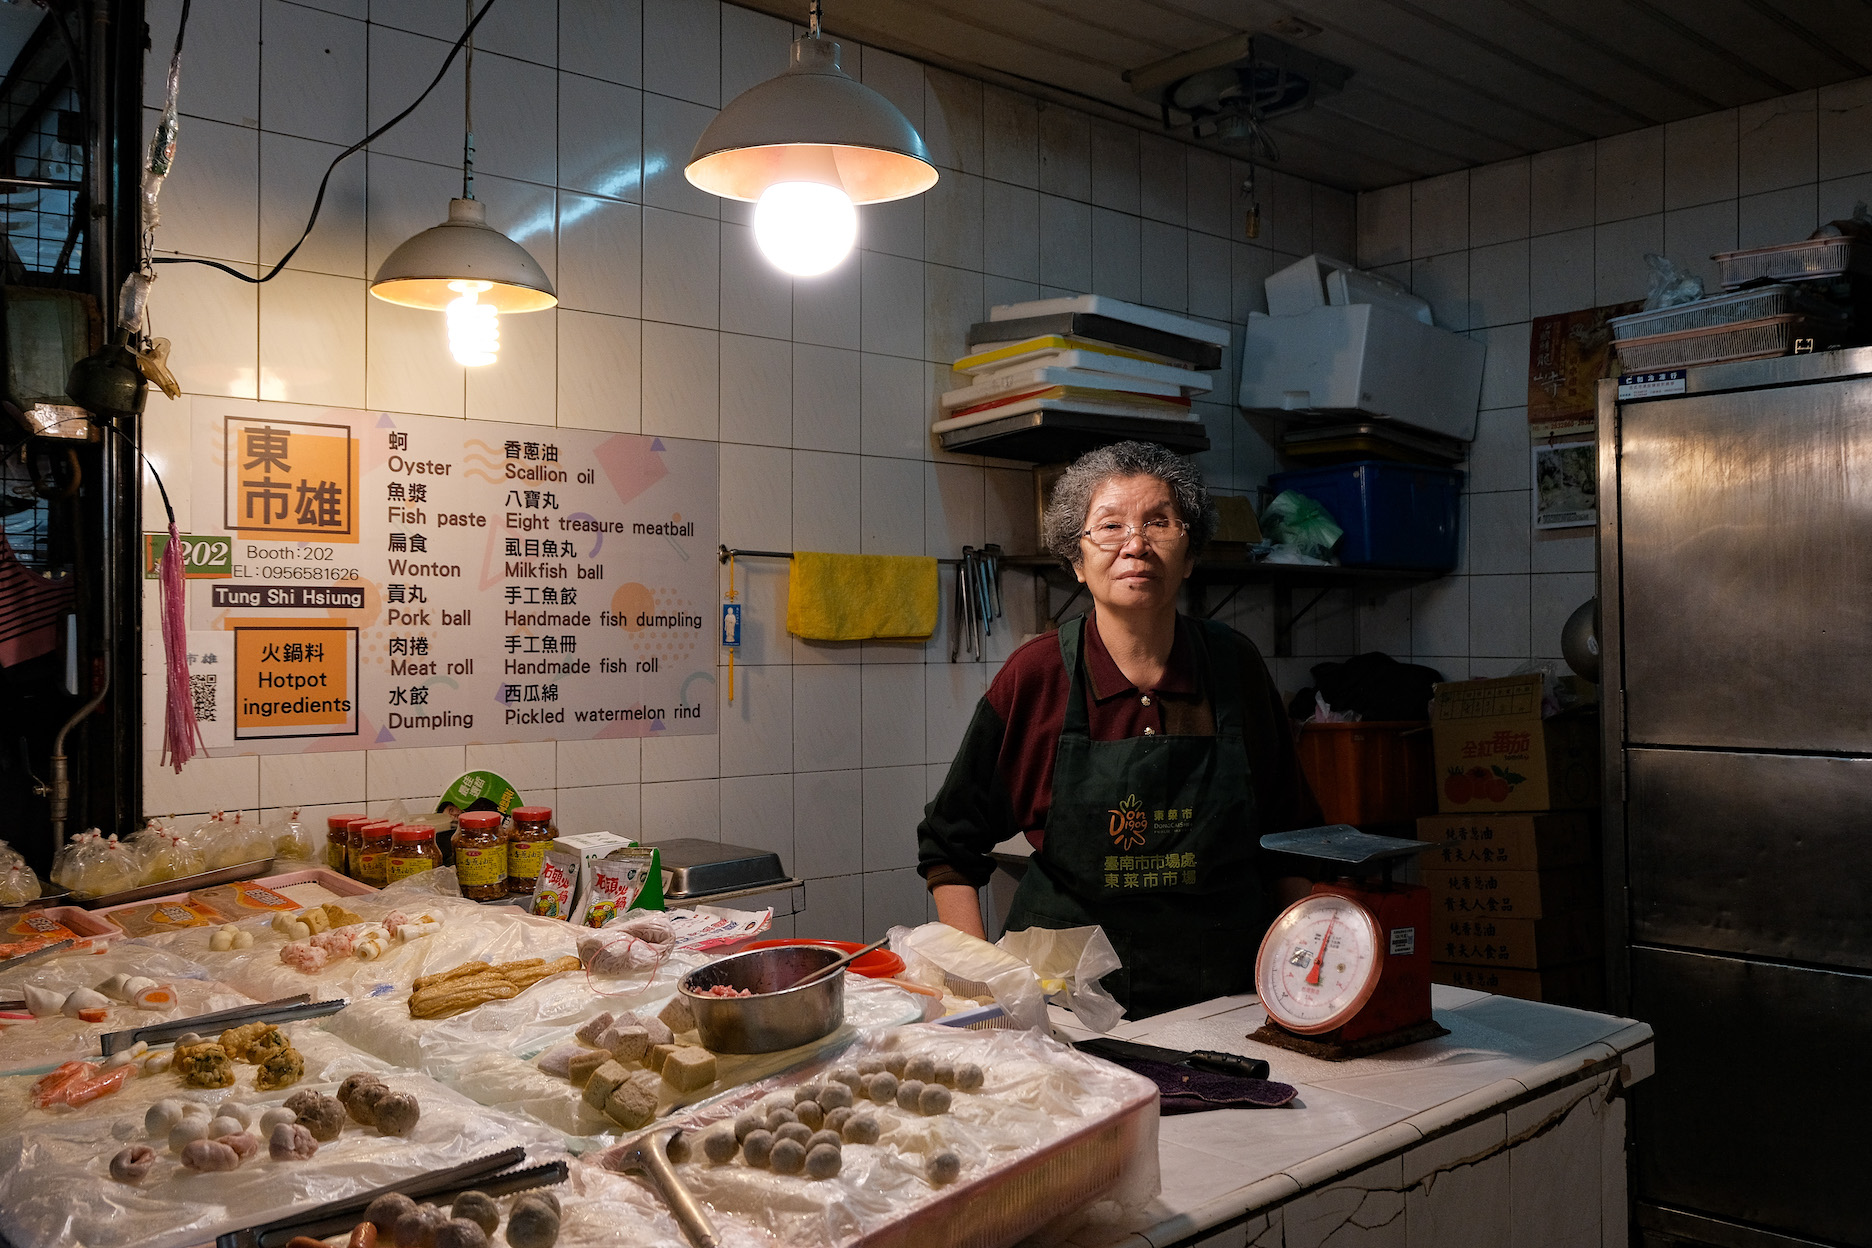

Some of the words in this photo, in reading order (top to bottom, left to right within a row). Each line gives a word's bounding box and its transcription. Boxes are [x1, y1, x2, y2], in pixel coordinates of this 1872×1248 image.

[243, 426, 292, 473] 東
[389, 432, 408, 451] 蚵
[505, 441, 558, 463] 香蔥油
[388, 456, 452, 476] Oyster
[505, 464, 567, 483] Scallion
[577, 469, 595, 485] oil
[242, 476, 342, 527] 市雄
[387, 482, 427, 503] 魚漿
[505, 490, 559, 510] 八寶丸
[388, 507, 427, 525] Fish
[437, 510, 486, 529] paste
[506, 513, 549, 532] Eight
[559, 516, 624, 534] treasure
[632, 521, 694, 537] meatball
[387, 533, 427, 553] 扁食
[505, 538, 577, 558] 虱目魚丸
[181, 541, 229, 566] 202
[388, 560, 461, 577] Wonton
[505, 562, 567, 579] Milkfish
[577, 564, 604, 580] ball
[216, 588, 260, 606] Tung
[267, 588, 294, 605] Shi
[303, 589, 362, 608] Hsiung
[387, 584, 427, 604] 貢丸
[504, 586, 578, 606] 手工魚餃
[388, 610, 430, 626] Pork
[442, 610, 471, 627] ball
[505, 610, 591, 626] Handmade
[600, 611, 627, 627] fish
[636, 612, 702, 629] dumpling
[261, 643, 324, 663] 火鍋料
[388, 637, 429, 657] 肉捲
[504, 635, 577, 654] 手工魚冊
[390, 660, 437, 676] Meat
[447, 659, 474, 675] roll
[505, 658, 591, 675] Handmade
[600, 658, 627, 674] fish
[636, 657, 659, 673] roll
[258, 671, 327, 690] Hotpot
[388, 685, 429, 706] 水餃
[504, 684, 559, 703] 西瓜綿
[244, 698, 351, 717] ingredients
[505, 707, 565, 725] Pickled
[574, 705, 665, 722] watermelon
[674, 703, 700, 719] rind
[388, 712, 474, 731] Dumpling
[1104, 851, 1197, 871] 臺南市市場處
[541, 862, 570, 905] 石頭火鍋
[1104, 870, 1197, 888] 東菜市市場
[594, 873, 629, 911] 石頭火鍋
